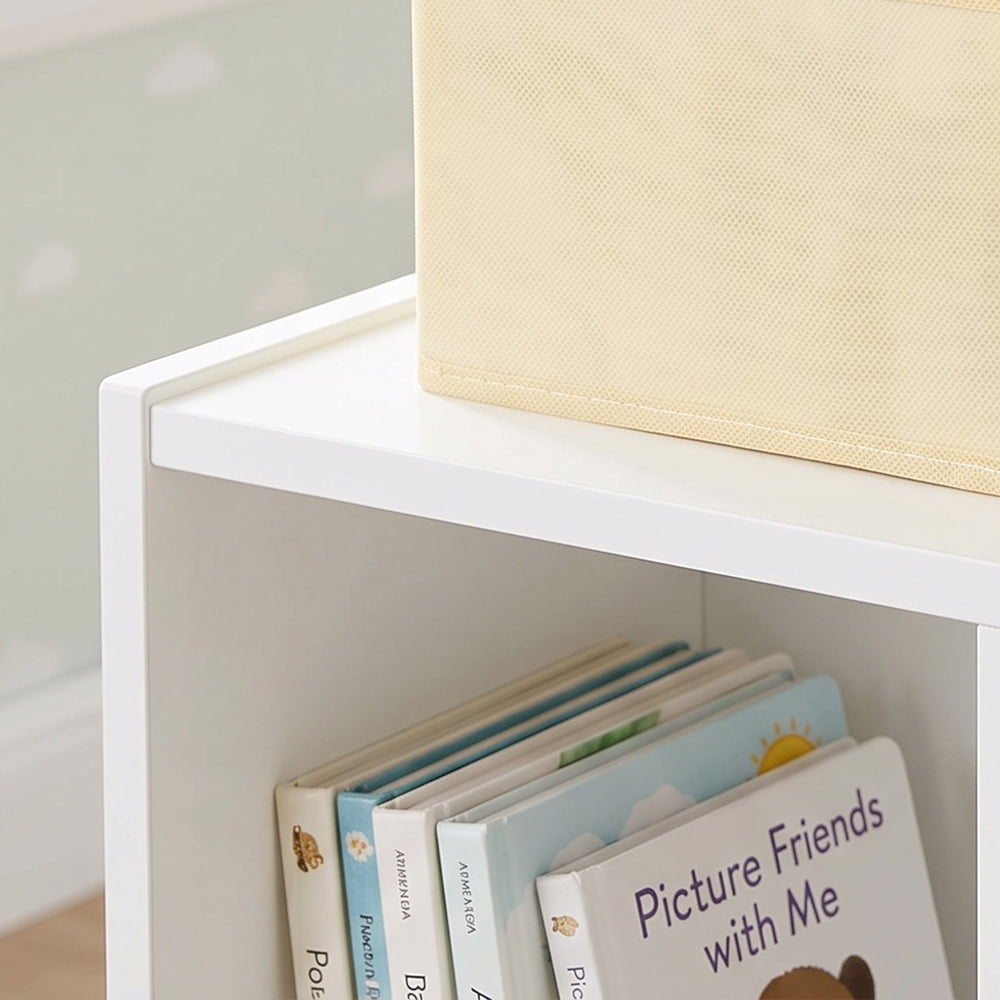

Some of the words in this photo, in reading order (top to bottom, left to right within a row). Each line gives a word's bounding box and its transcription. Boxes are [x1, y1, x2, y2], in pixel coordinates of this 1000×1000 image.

[634, 856, 762, 939] Picture
[768, 788, 884, 875] Friends
[704, 902, 779, 974] with
[787, 879, 840, 936] Me
[567, 966, 587, 1000] Pic
